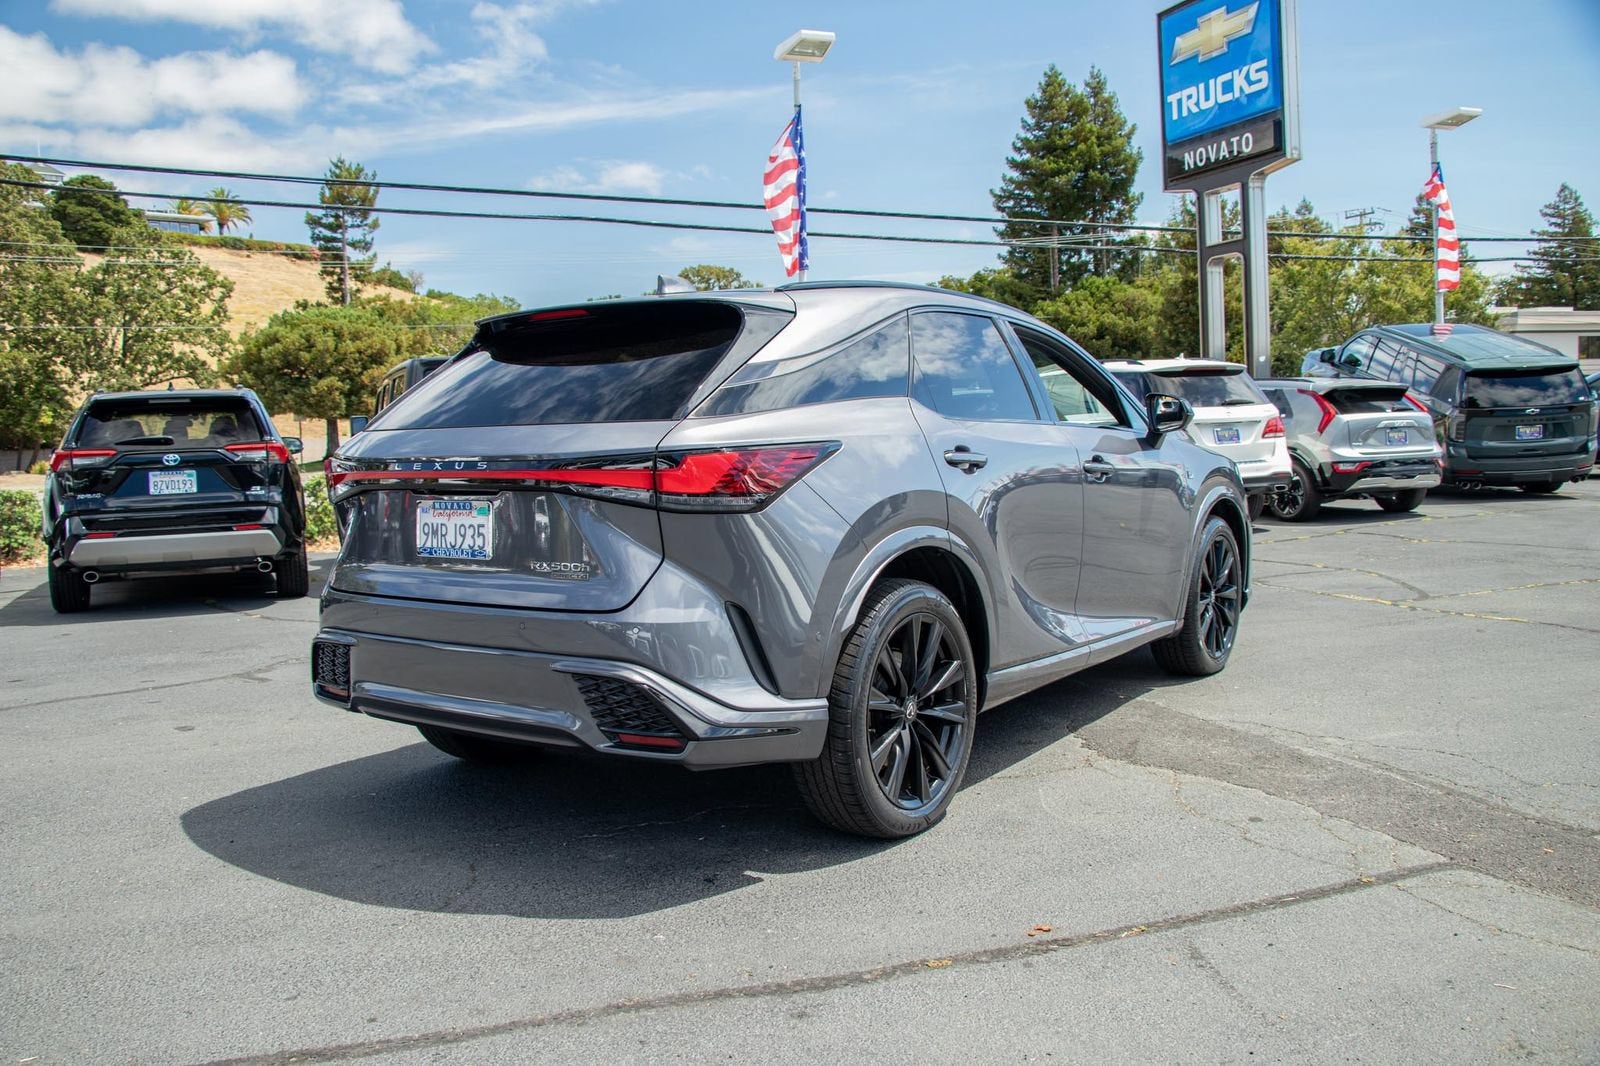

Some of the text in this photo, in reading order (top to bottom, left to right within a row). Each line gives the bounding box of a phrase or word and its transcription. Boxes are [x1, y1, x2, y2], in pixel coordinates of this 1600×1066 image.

[1167, 58, 1269, 120] TRUCKS
[1184, 132, 1253, 171] NOVATO
[394, 461, 488, 471] LEXUS
[152, 479, 194, 492] 8ZVD193
[434, 502, 471, 510] NOVATO
[422, 522, 486, 550] 9MRJ935
[432, 547, 472, 558] CHEVROLET
